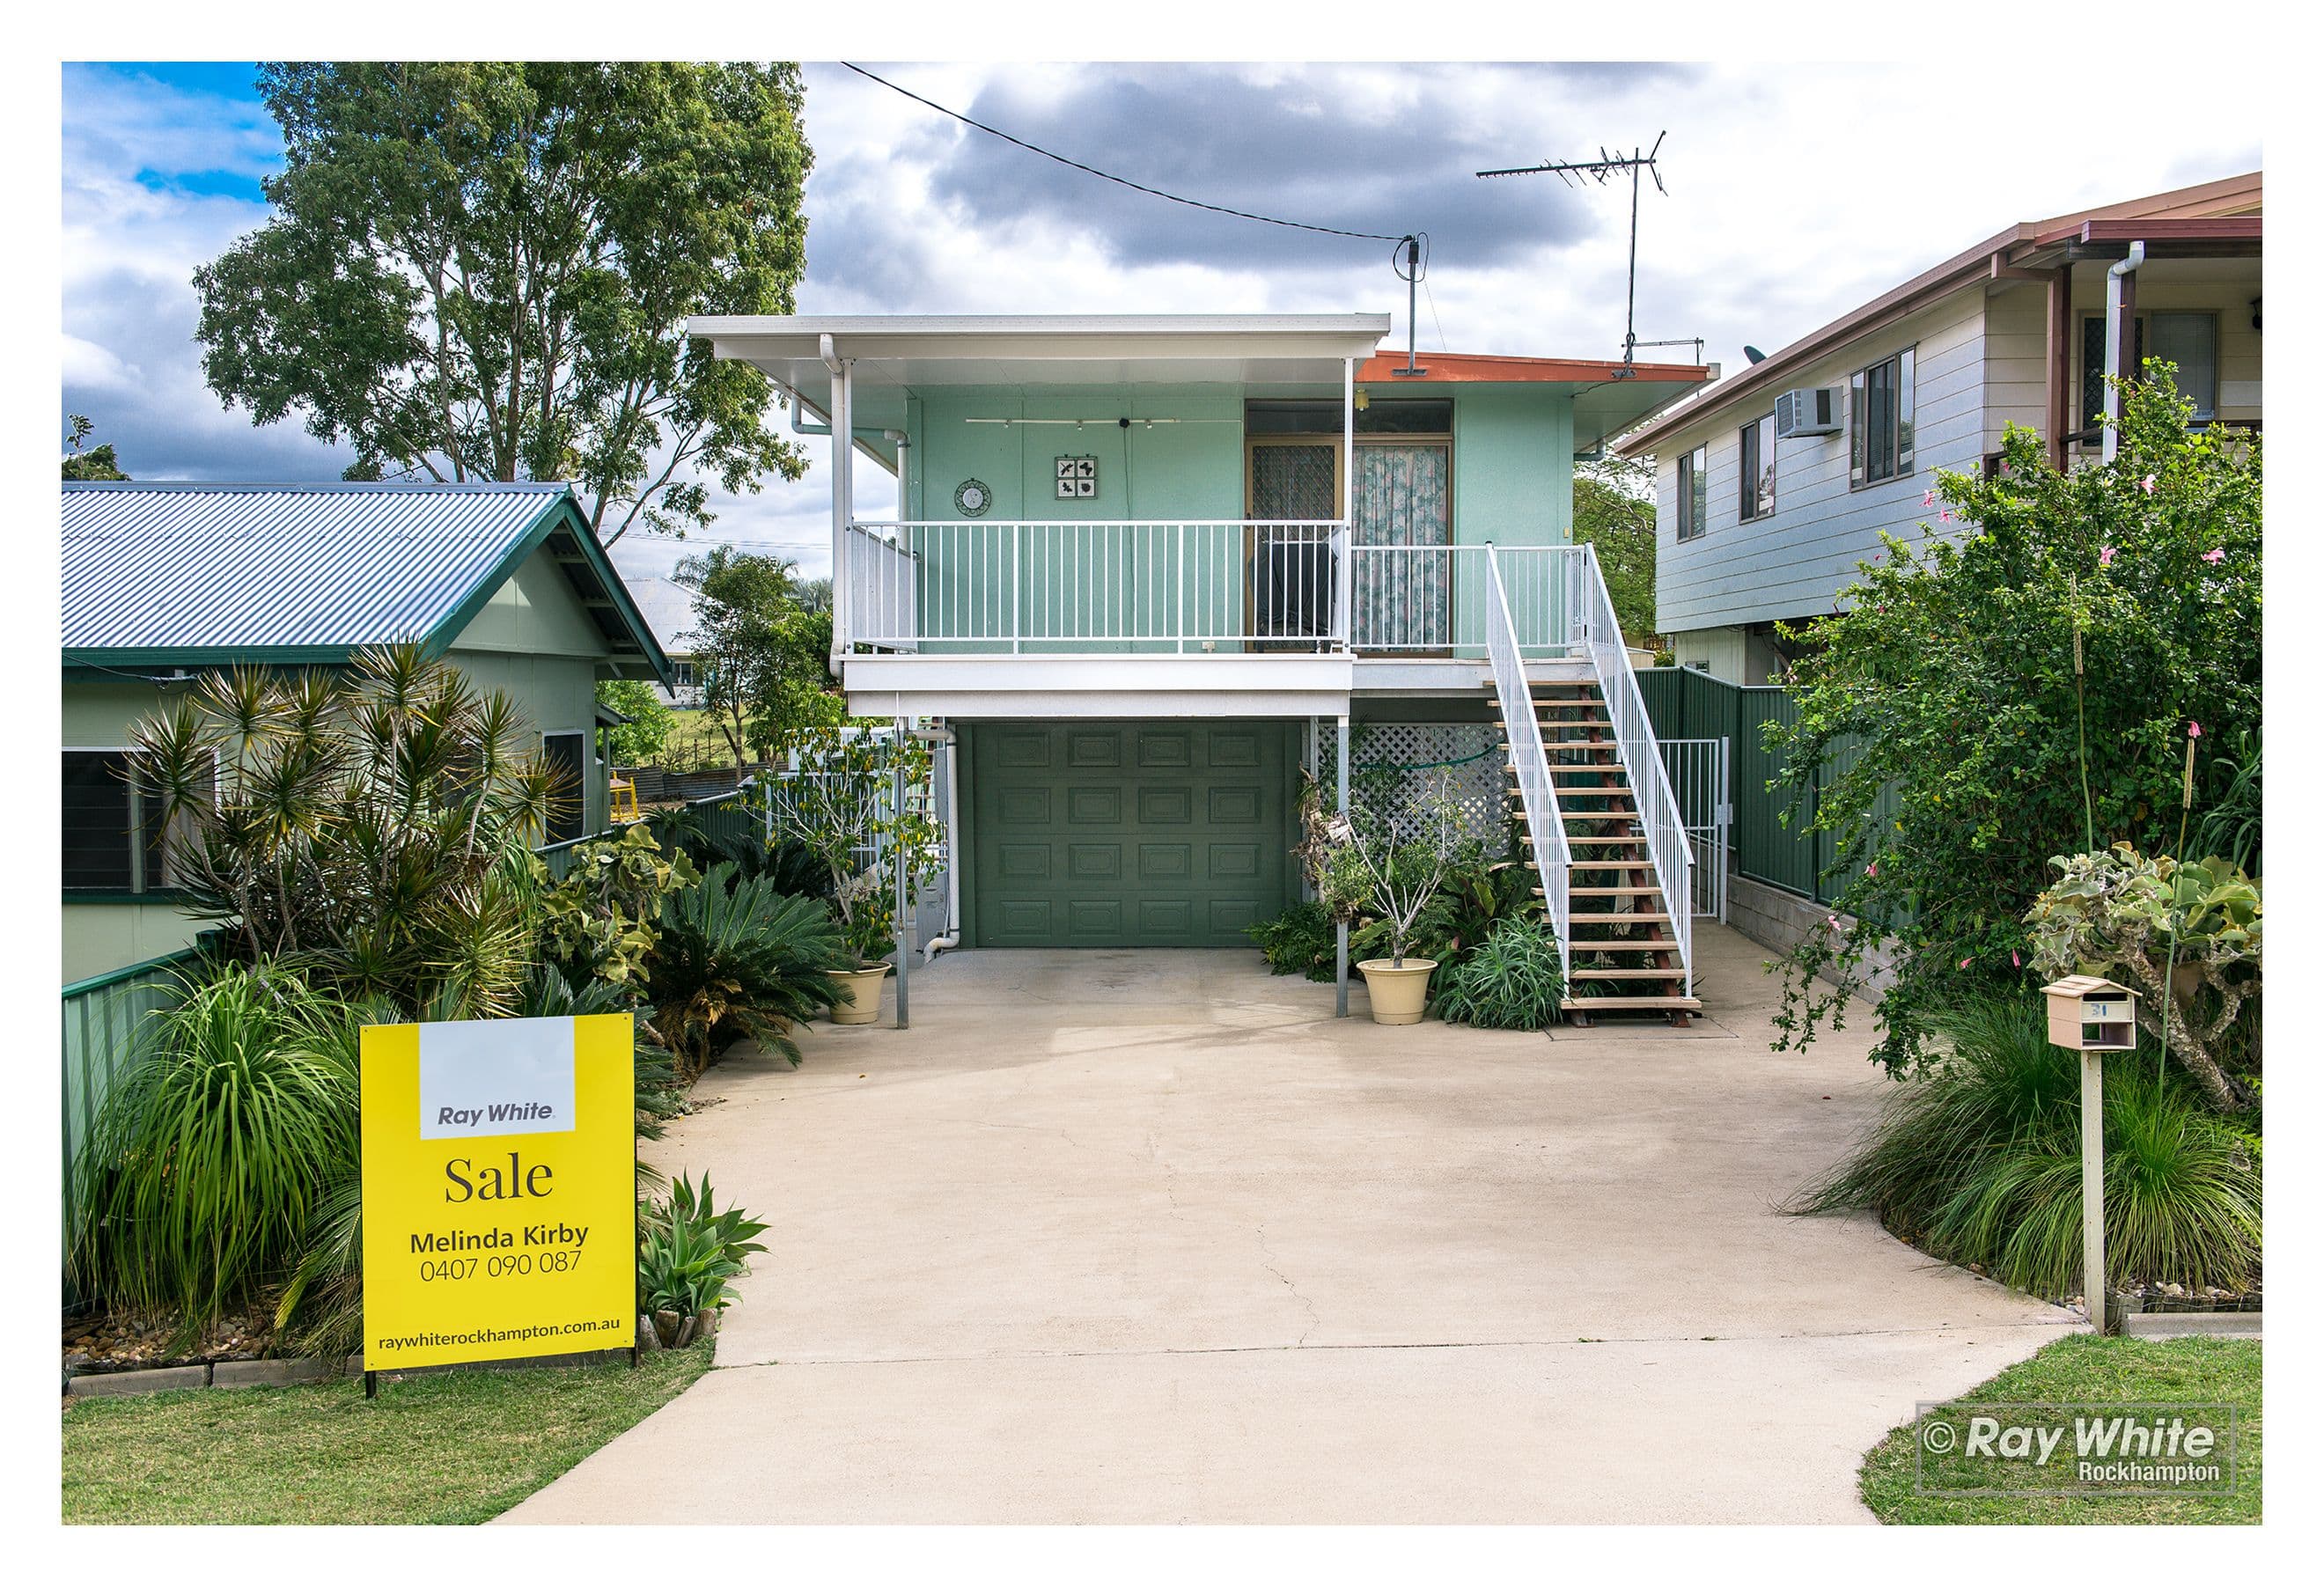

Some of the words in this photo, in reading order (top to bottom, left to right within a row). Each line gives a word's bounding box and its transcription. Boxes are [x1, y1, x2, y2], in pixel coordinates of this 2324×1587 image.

[438, 1106, 483, 1127] Ray
[488, 1102, 553, 1121] White
[445, 1152, 553, 1203] Sale
[410, 1227, 513, 1253] Melinda
[523, 1223, 589, 1247] Kirby
[420, 1258, 477, 1282] 0407
[487, 1254, 532, 1277] 090
[539, 1250, 582, 1274] 087
[379, 1319, 621, 1350] raywhiterockhampton.com.au
